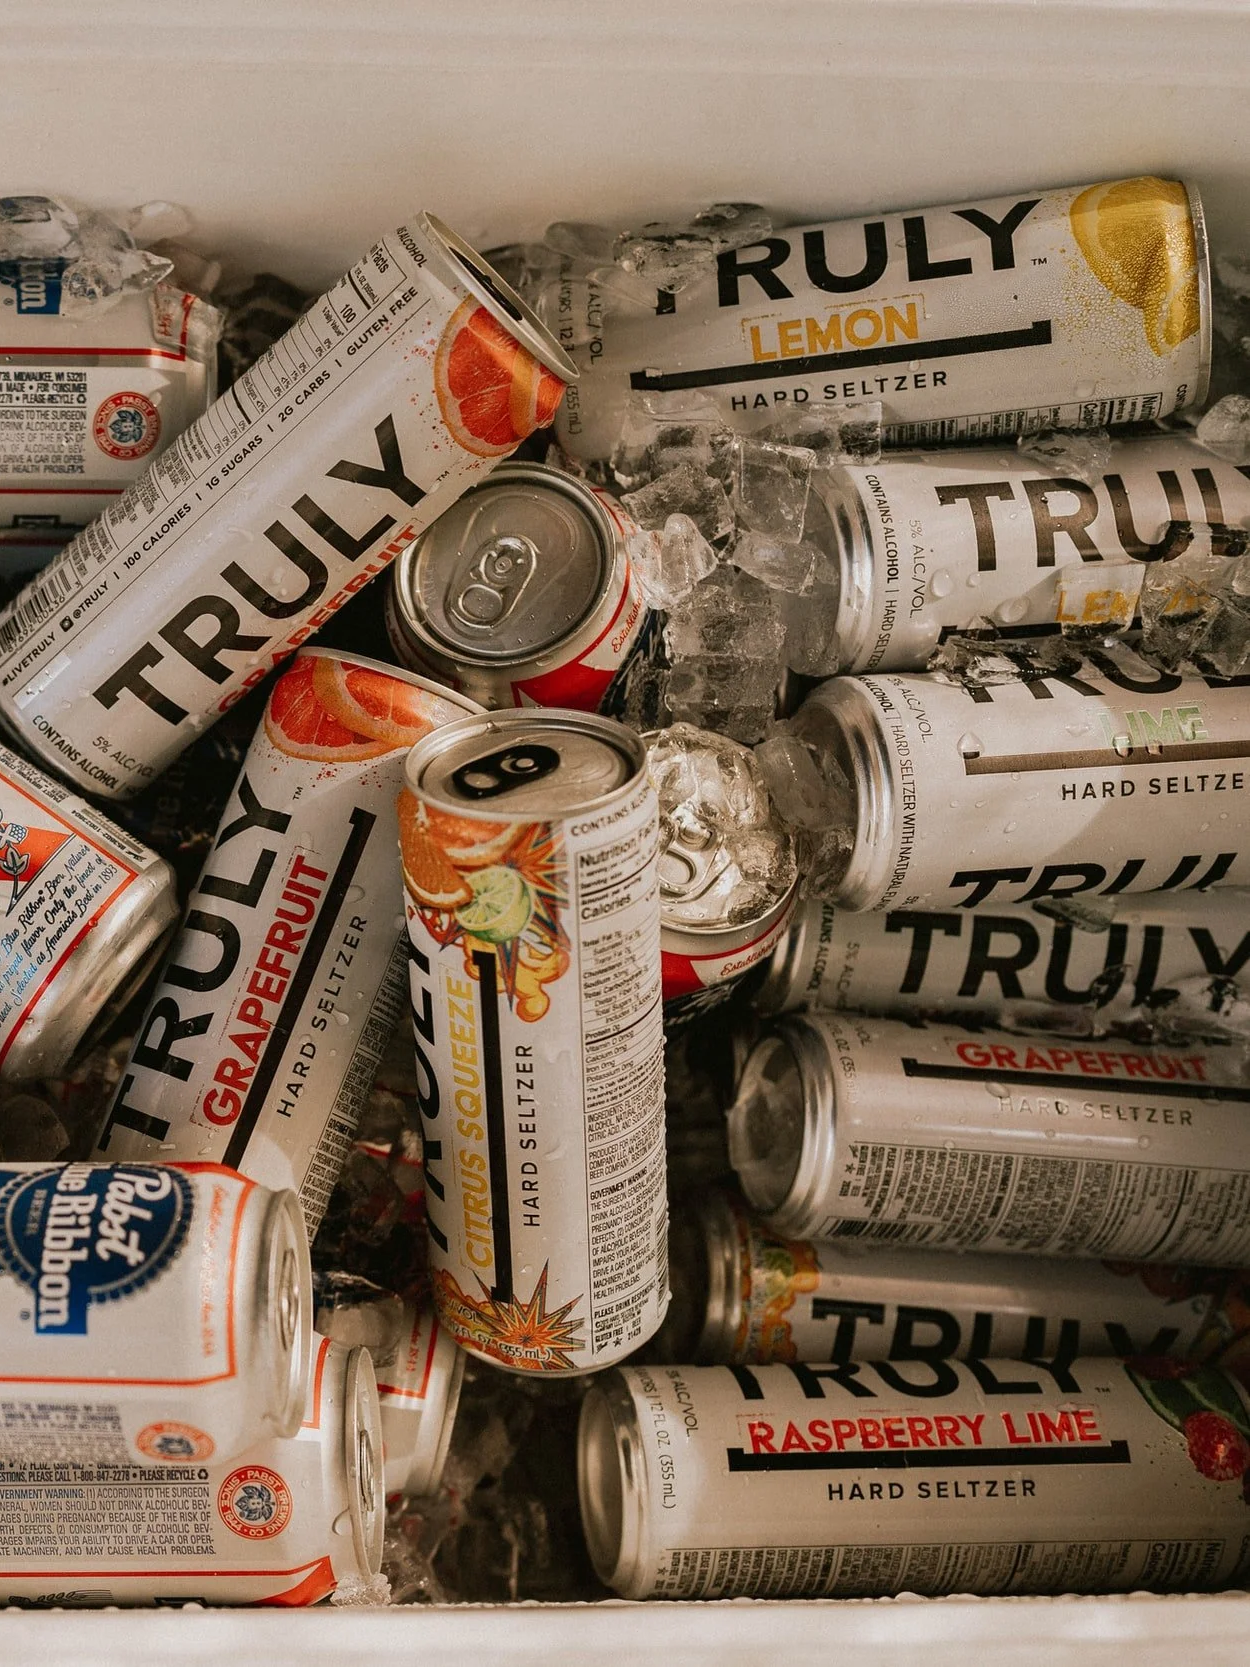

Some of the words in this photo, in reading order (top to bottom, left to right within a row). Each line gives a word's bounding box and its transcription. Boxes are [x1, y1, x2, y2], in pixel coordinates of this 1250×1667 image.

[655, 198, 1043, 316] RULY
[339, 303, 356, 324] 100
[751, 303, 920, 363] LEMON
[732, 387, 810, 412] HARD
[824, 372, 949, 401] SELTZER
[0, 630, 59, 687] #LIVETRULY
[70, 579, 112, 620] @TRULY
[121, 549, 144, 571] 100
[140, 501, 193, 553] CALORIES
[204, 474, 222, 492] 1G
[219, 433, 265, 478] SUGARS
[276, 403, 296, 423] 2G
[293, 368, 333, 407] CARBS
[344, 313, 390, 358] GLUTEN
[388, 285, 420, 316] FREE
[865, 474, 892, 522] CONTAINS
[908, 519, 922, 540] 5%
[935, 466, 1250, 572] TRUL
[92, 413, 427, 726] TRULY
[883, 524, 900, 584] ALCOHOL
[884, 600, 897, 632] HARD
[866, 681, 894, 713] ALCOHOL
[92, 735, 112, 753] 5%
[891, 725, 910, 757] HARD
[1099, 706, 1209, 748] LIME
[32, 715, 81, 761] CONTAINS
[77, 758, 120, 789] ALCOHOL
[899, 759, 917, 811] SELTZER
[1061, 779, 1136, 801] HARD
[1148, 772, 1250, 796] SELTZE
[903, 813, 916, 844] WITH
[579, 834, 638, 868] Nutrition
[44, 898, 68, 926] Only
[63, 884, 78, 899] the
[75, 861, 96, 889] finest
[95, 853, 107, 866] of
[581, 894, 631, 919] Calories
[0, 927, 20, 958] Blue
[10, 962, 37, 1007] Selected
[36, 954, 47, 966] as
[44, 909, 78, 963] America's
[74, 888, 95, 918] Best
[92, 882, 102, 895] in
[99, 863, 119, 886] 1893
[97, 771, 293, 1152] TRULY
[203, 855, 330, 1127] GRAPEFRUIT
[277, 1041, 318, 1119] HARD
[316, 914, 369, 1033] SELTZER
[451, 974, 486, 1143] SQUEEZE
[957, 1042, 1209, 1082] GRAPEFRUIT
[514, 1043, 535, 1150] SELTZER
[1000, 1096, 1071, 1117] HARD
[1081, 1100, 1194, 1127] SELTZER
[463, 1146, 494, 1267] CITRUS
[522, 1152, 542, 1228] HARD
[590, 1178, 627, 1201] GOVERNMENT
[95, 1171, 172, 1267] Pabst
[37, 1193, 99, 1330] Ribbon
[594, 1305, 615, 1319] PLEASE
[653, 1413, 663, 1428] FL
[658, 1454, 675, 1479] (355
[749, 1413, 985, 1455] RASPBERRY
[1006, 1409, 1101, 1444] LIME
[28, 1470, 52, 1480] PLEASE
[54, 1470, 71, 1480] CALL
[140, 1470, 164, 1480] PLEASE
[166, 1469, 195, 1480] RECYCLE
[45, 1488, 85, 1498] WARNING:
[86, 1488, 94, 1498] (1)
[97, 1487, 143, 1498] ACCORDING
[144, 1487, 154, 1497] TO
[156, 1486, 170, 1497] THE
[172, 1486, 209, 1498] SURGEON
[221, 1475, 241, 1508] SINCE
[247, 1470, 282, 1489] PABST
[827, 1480, 906, 1501] HARD
[917, 1478, 1037, 1500] SELTZER
[31, 1500, 62, 1510] WOMEN
[65, 1500, 96, 1510] SHOULD
[99, 1500, 114, 1510] NOT
[118, 1500, 143, 1510] DRINK
[146, 1499, 189, 1510] ALCOHOLIC
[192, 1499, 210, 1510] BEV-
[223, 1510, 244, 1532] 1844
[265, 1489, 290, 1534] BREWING
